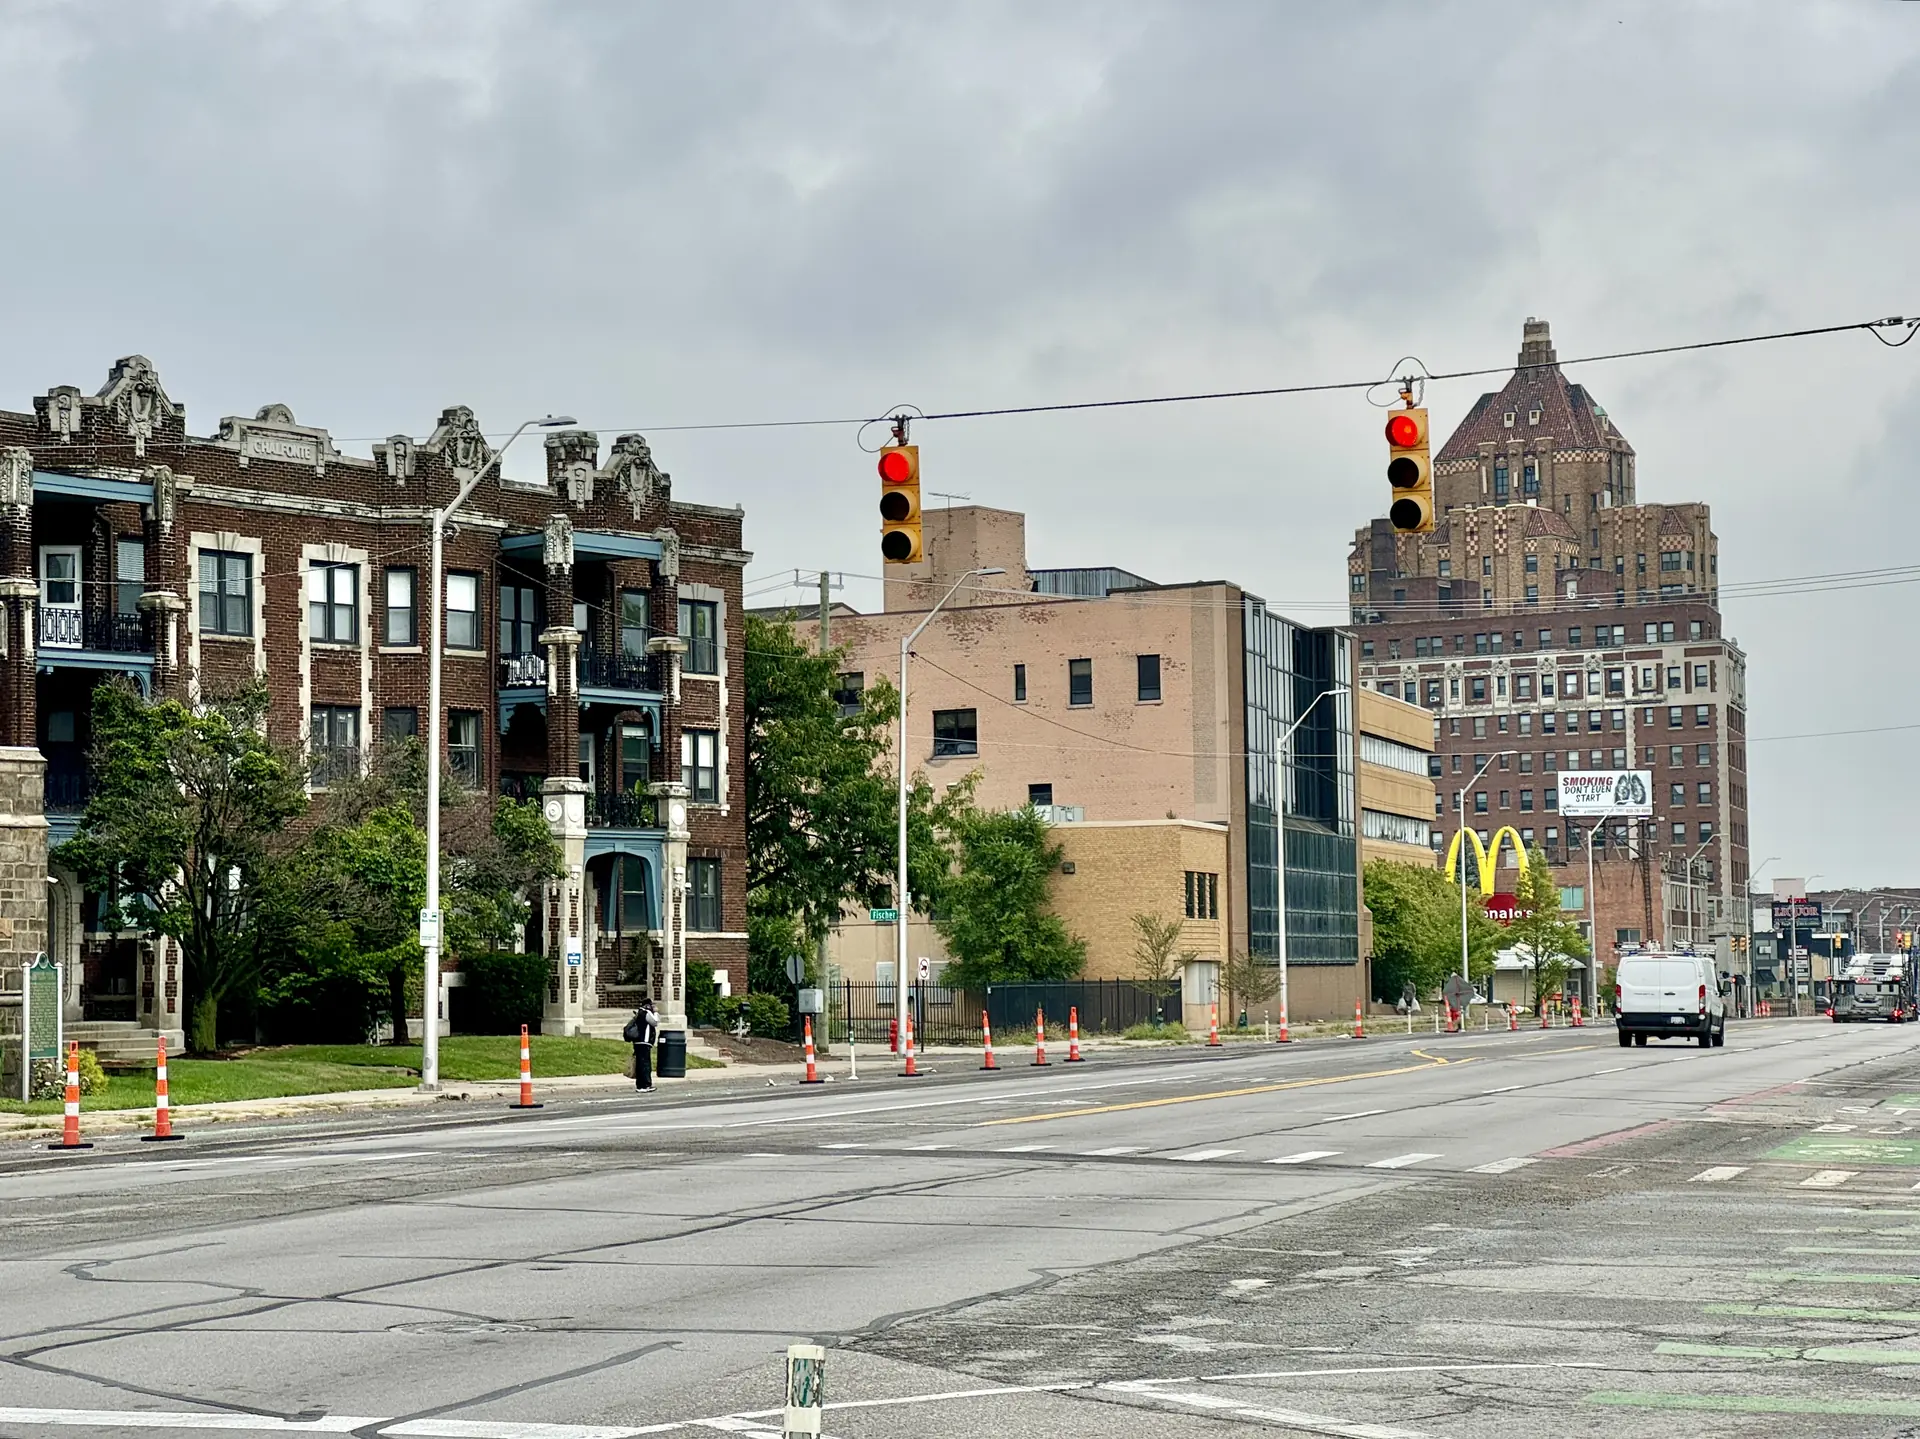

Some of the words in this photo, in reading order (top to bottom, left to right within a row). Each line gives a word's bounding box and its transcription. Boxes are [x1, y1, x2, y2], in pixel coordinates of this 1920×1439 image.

[254, 442, 311, 460] CHALFONTE
[1562, 776, 1613, 786] SMOKING
[1565, 785, 1589, 794] DONT
[1591, 785, 1612, 793] EVEN
[1576, 793, 1601, 802] START
[873, 911, 896, 919] Fischer
